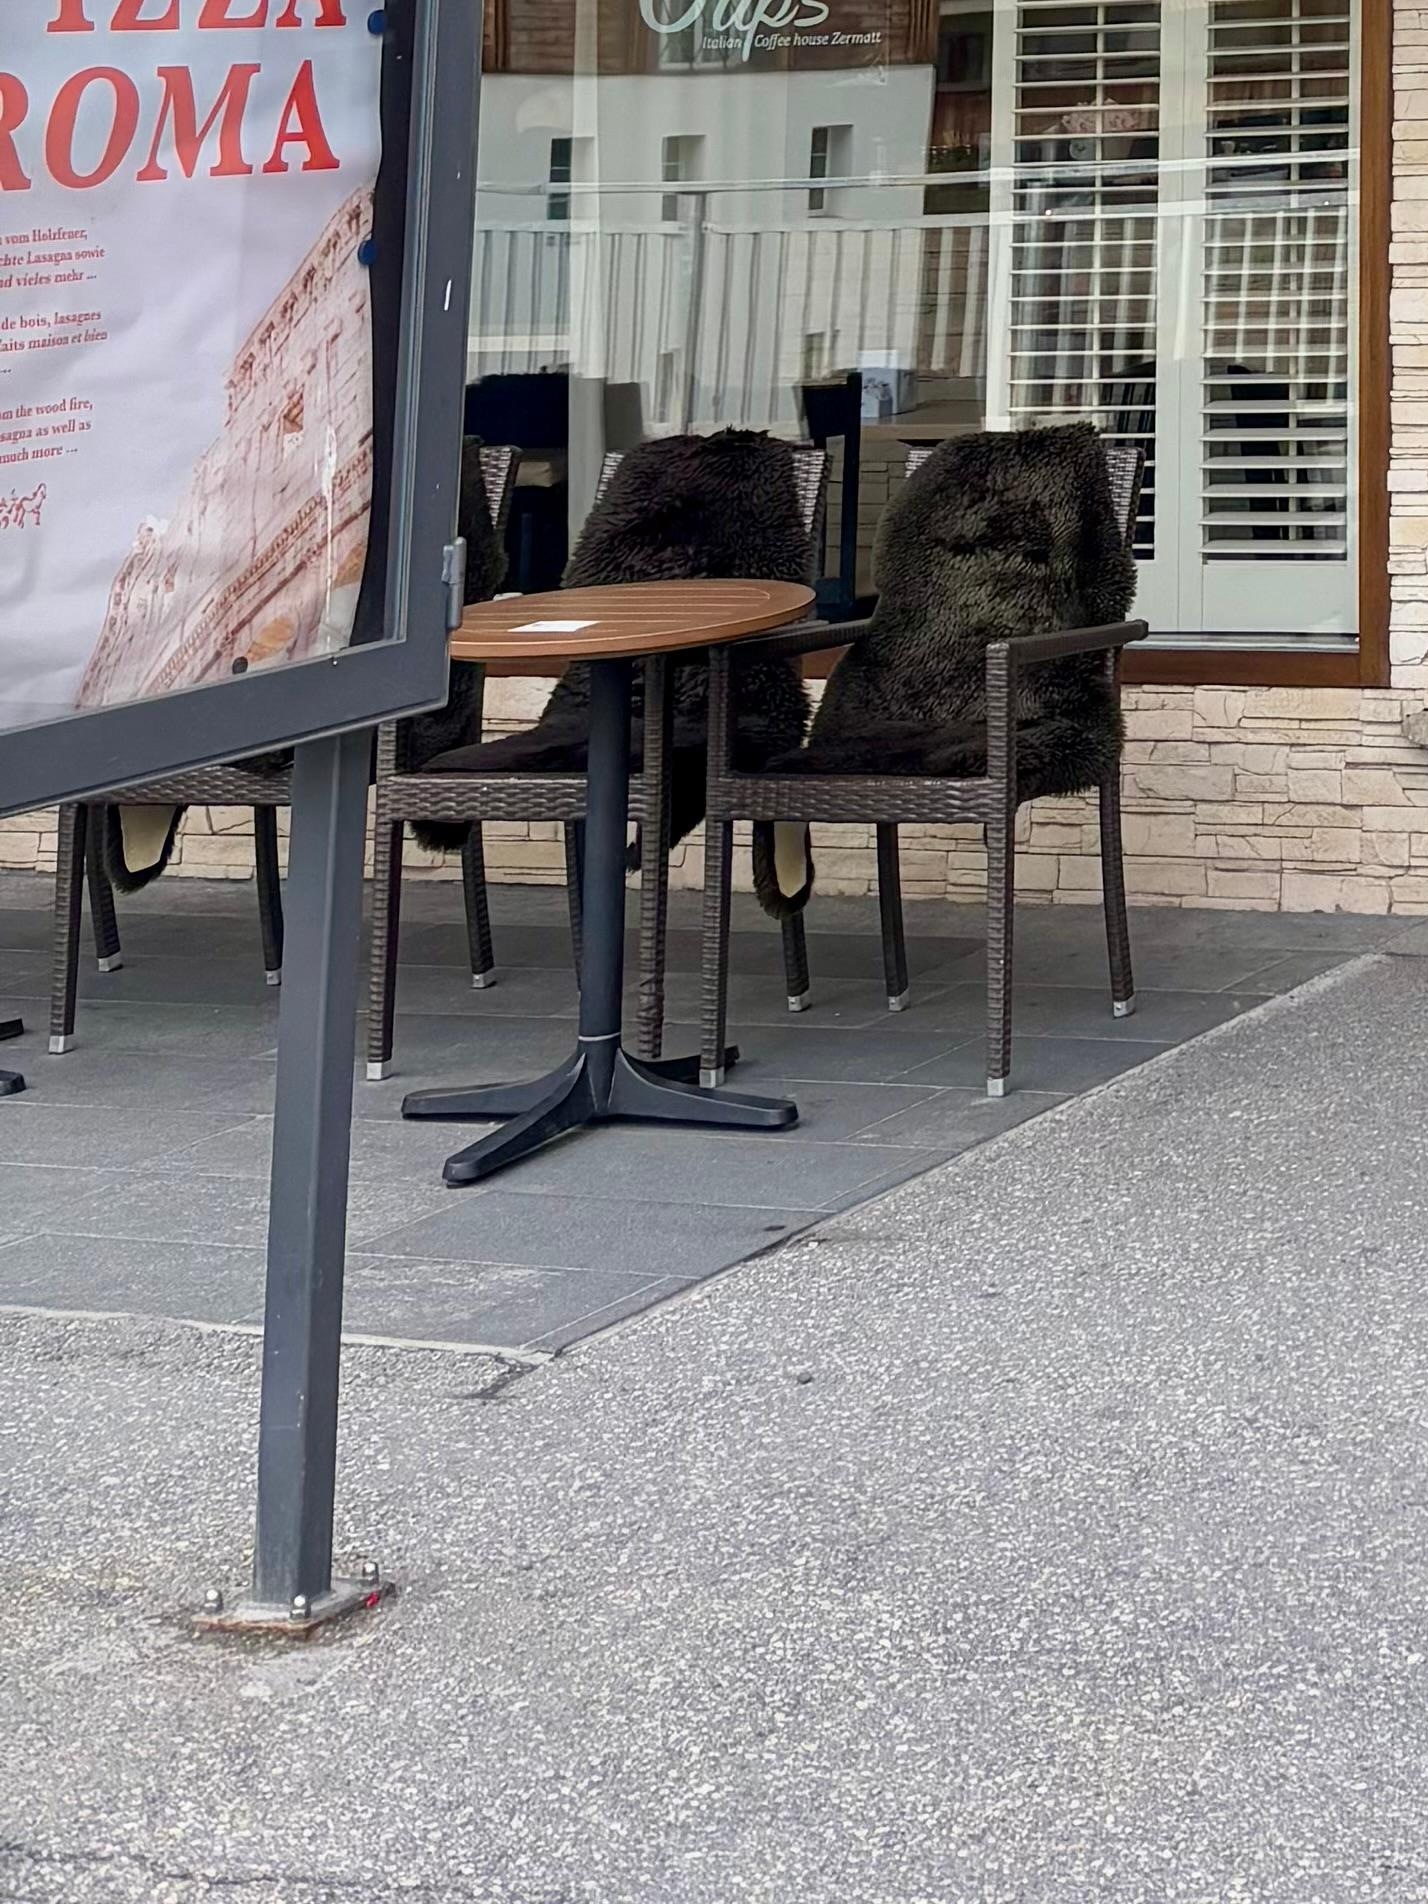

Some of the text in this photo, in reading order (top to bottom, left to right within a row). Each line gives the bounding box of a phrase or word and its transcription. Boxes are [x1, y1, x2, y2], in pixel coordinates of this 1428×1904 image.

[703, 31, 882, 50] Italian Coffee house Zermatt
[26, 251, 73, 266] Lasagna
[75, 245, 105, 260] sowie
[16, 272, 52, 286] vieles
[54, 269, 84, 283] mehr
[1, 311, 102, 330] de bois, lasagnes
[28, 334, 69, 349] maison
[71, 334, 82, 344] et
[16, 405, 33, 418] the
[35, 399, 66, 415] wood
[69, 397, 93, 411] fire,
[35, 427, 49, 437] as
[51, 419, 75, 434] well
[78, 420, 91, 431] as
[0, 447, 29, 464] much
[31, 447, 63, 459] more
